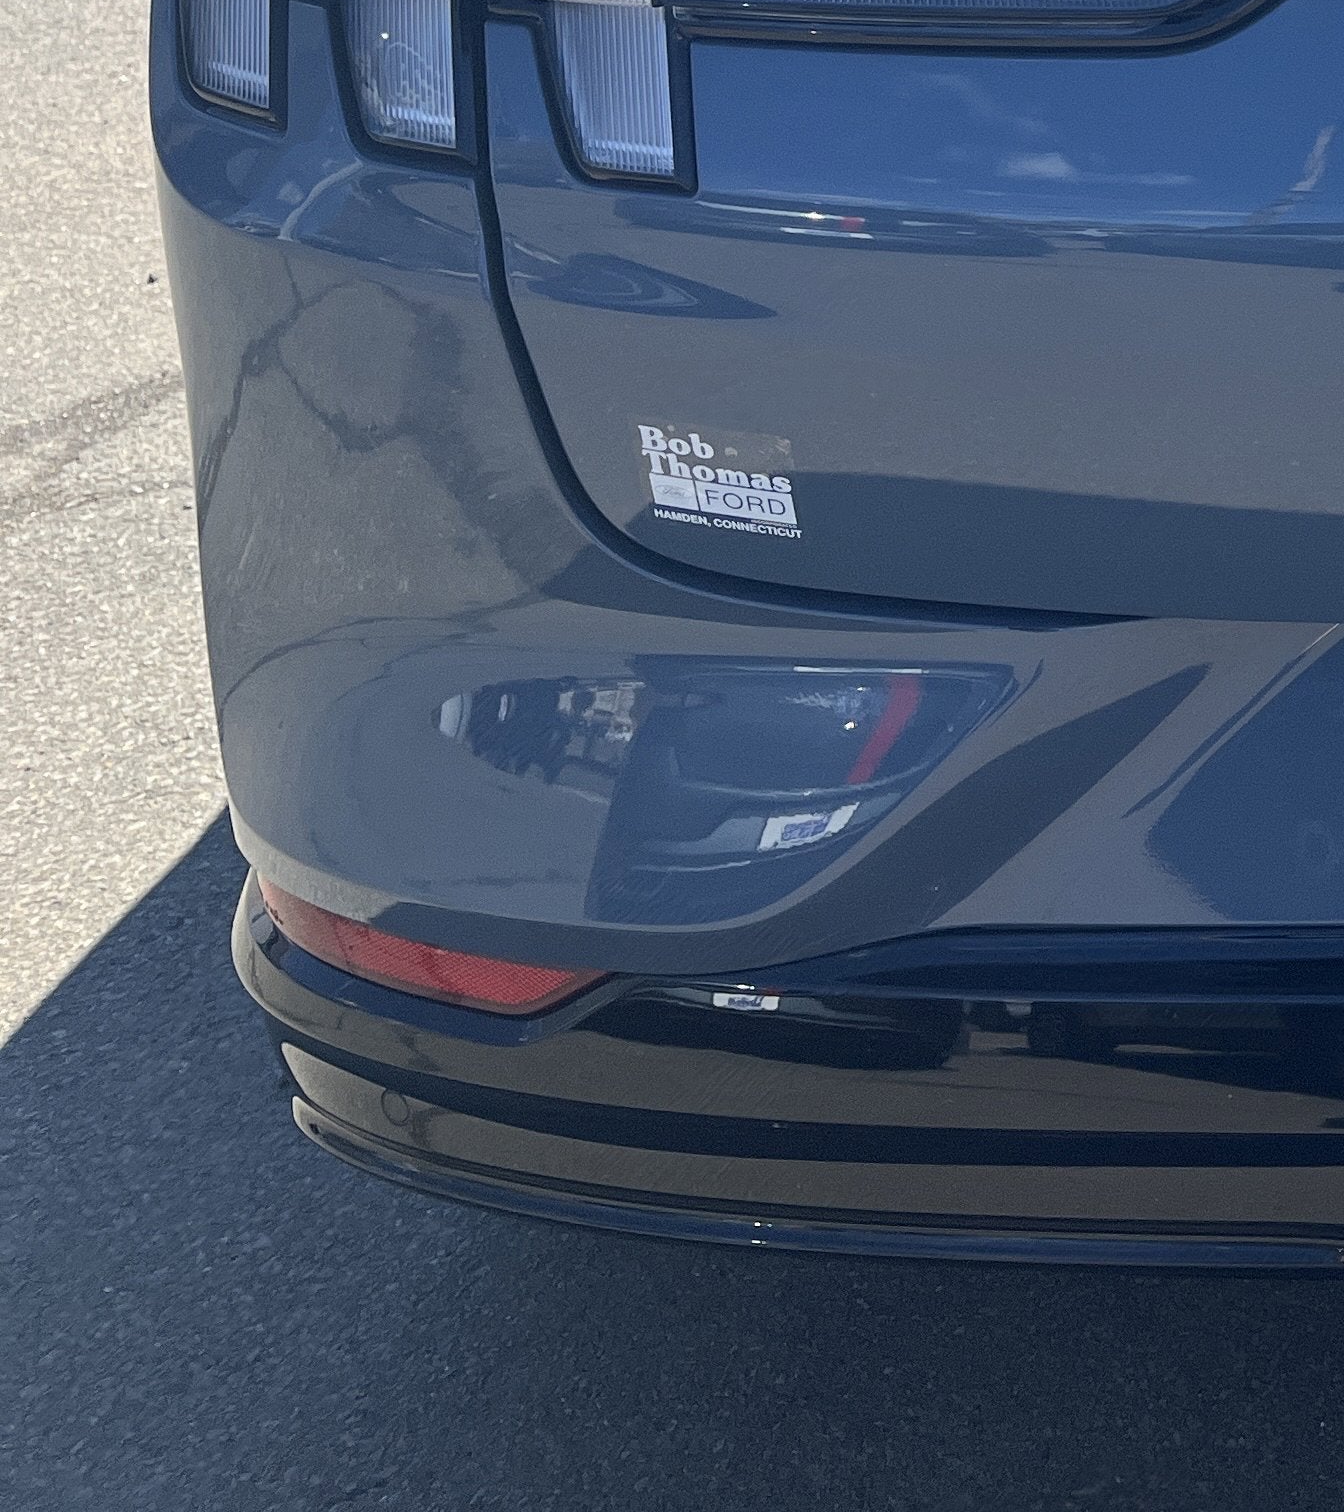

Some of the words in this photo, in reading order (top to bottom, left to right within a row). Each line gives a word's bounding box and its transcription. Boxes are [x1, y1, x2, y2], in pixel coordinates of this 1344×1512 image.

[638, 425, 714, 459] Bob
[642, 449, 792, 493] Thomas
[704, 490, 786, 515] FORD
[654, 508, 711, 528] HAMDEN,
[713, 518, 802, 539] CONNECTICUT
